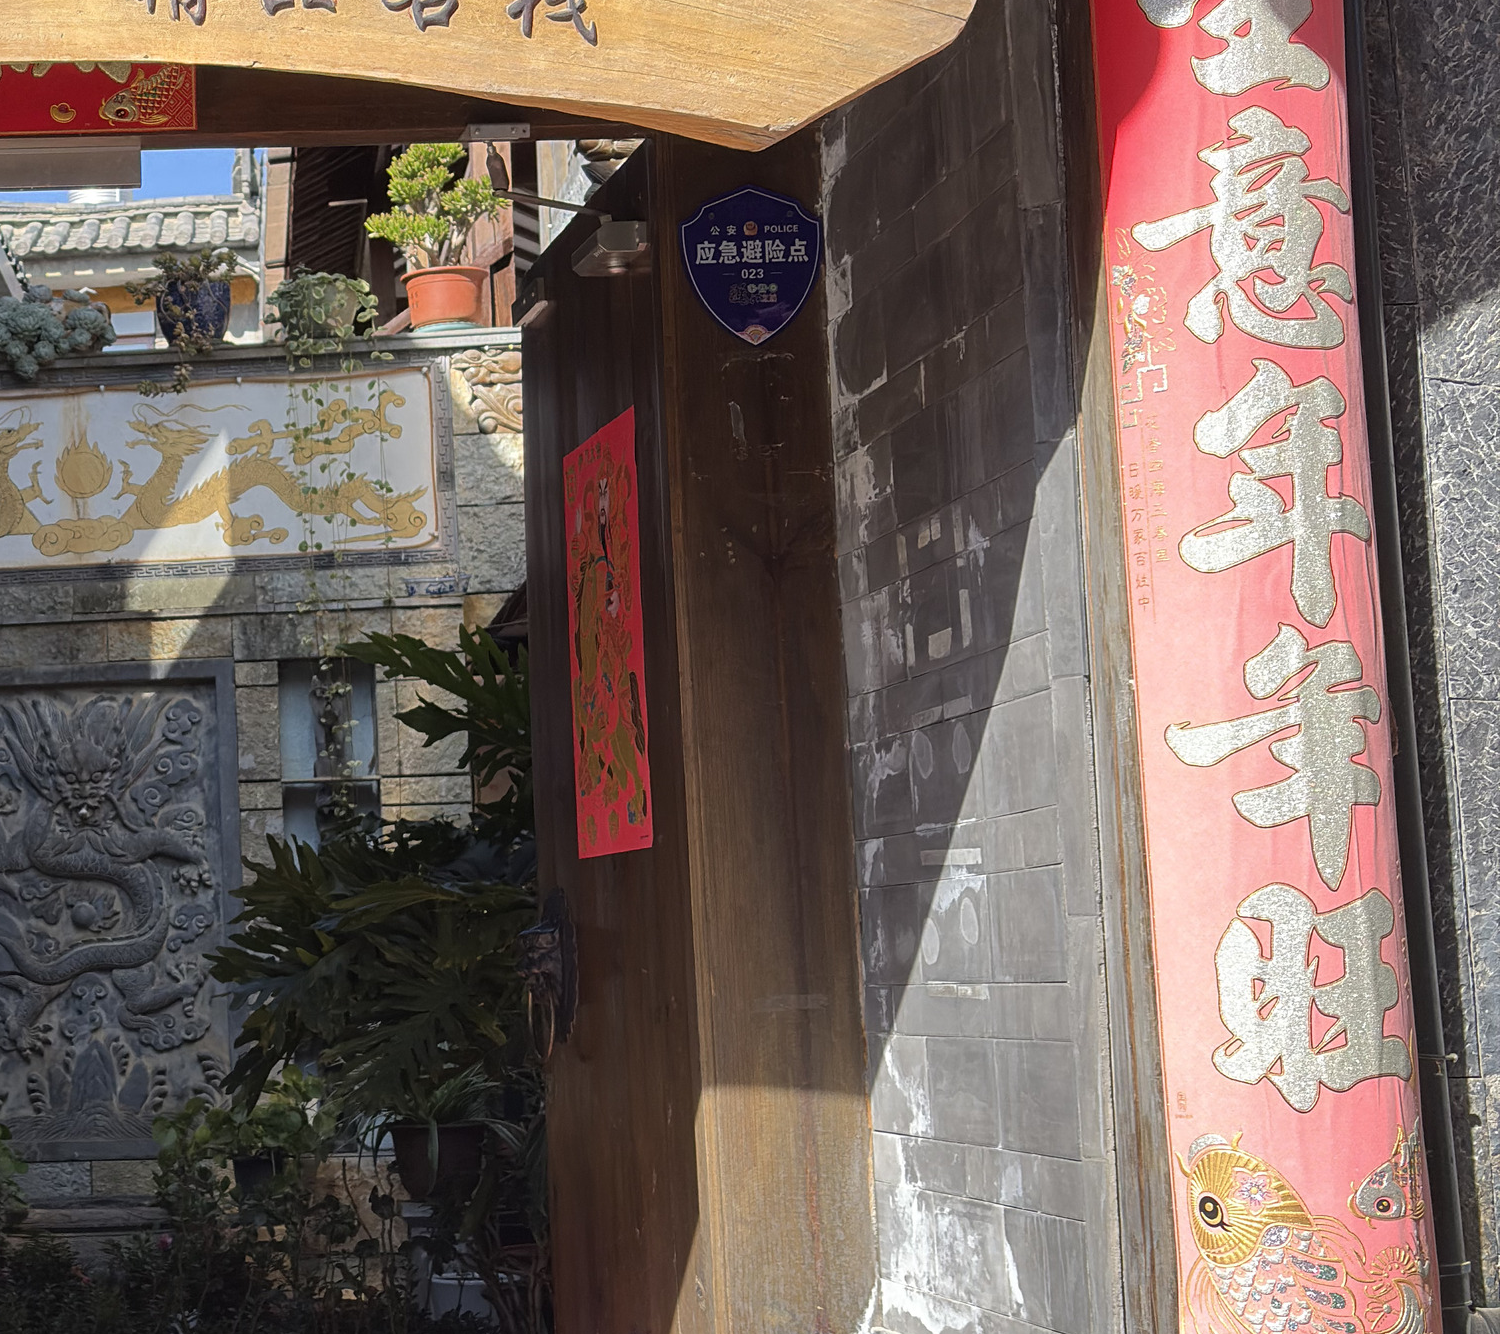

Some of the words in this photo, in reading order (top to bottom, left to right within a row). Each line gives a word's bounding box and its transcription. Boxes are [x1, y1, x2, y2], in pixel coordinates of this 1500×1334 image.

[710, 224, 737, 236] 公安
[764, 224, 799, 234] POLICE
[695, 238, 809, 265] 应急避险点
[741, 268, 764, 279] 023
